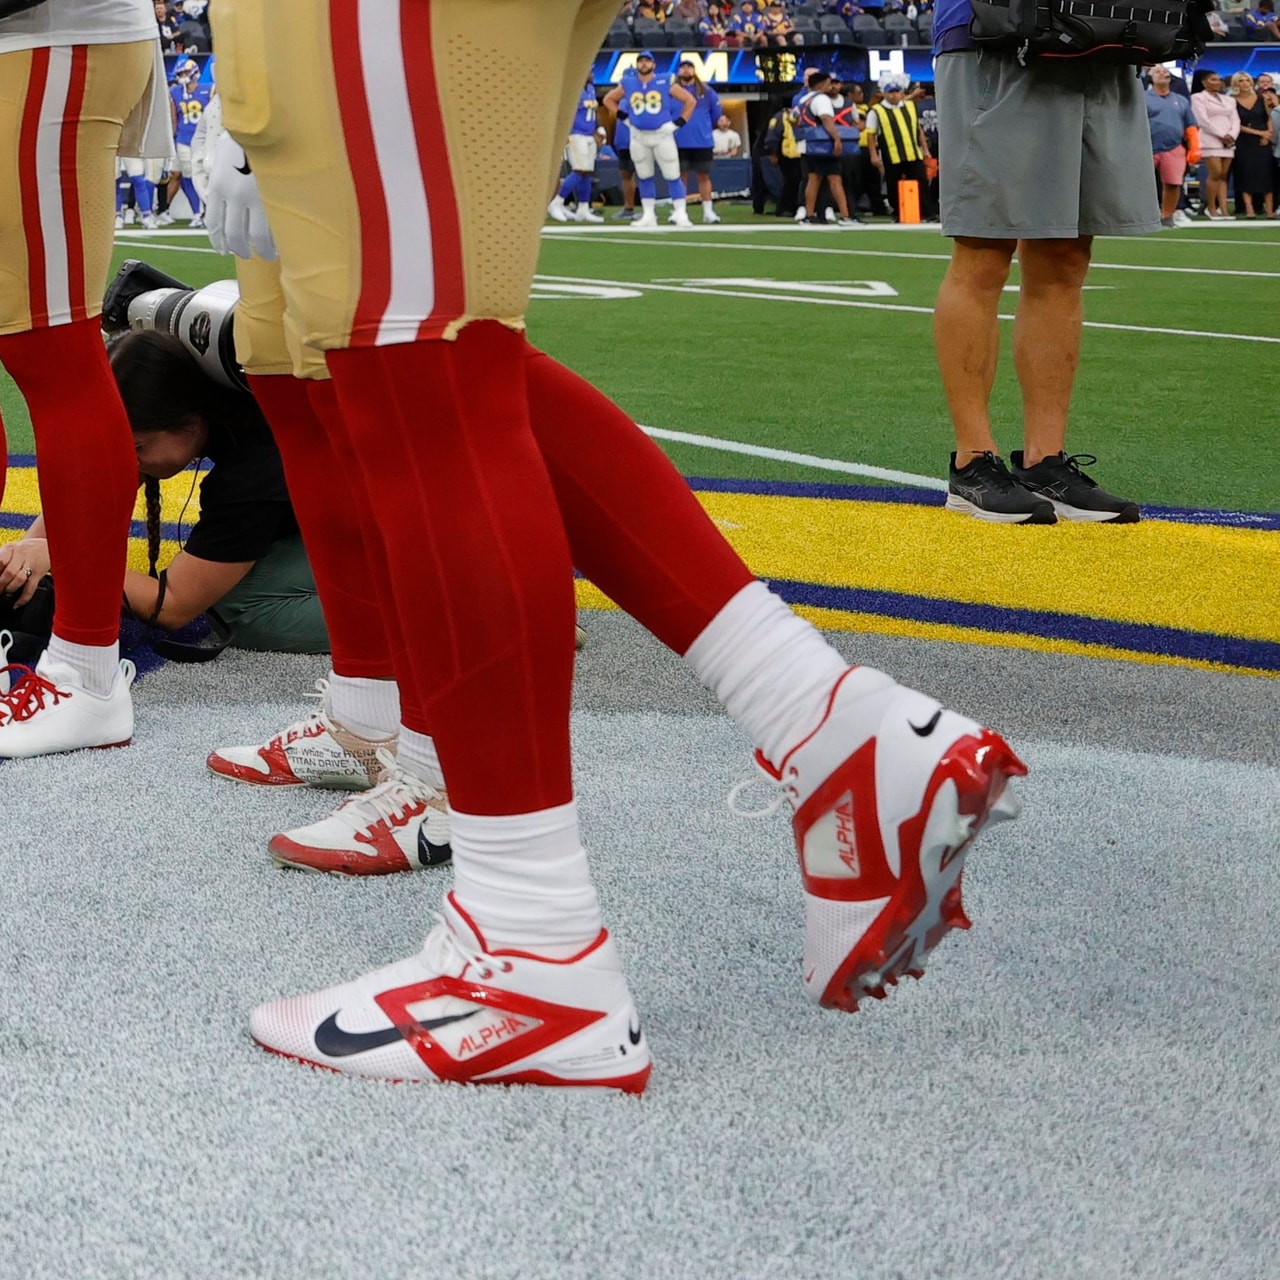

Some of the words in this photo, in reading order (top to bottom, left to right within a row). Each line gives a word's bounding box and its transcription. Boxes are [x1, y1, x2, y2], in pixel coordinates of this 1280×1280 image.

[629, 90, 662, 115] 68
[834, 801, 858, 874] ALPHA
[457, 1016, 528, 1057] ALPHA
